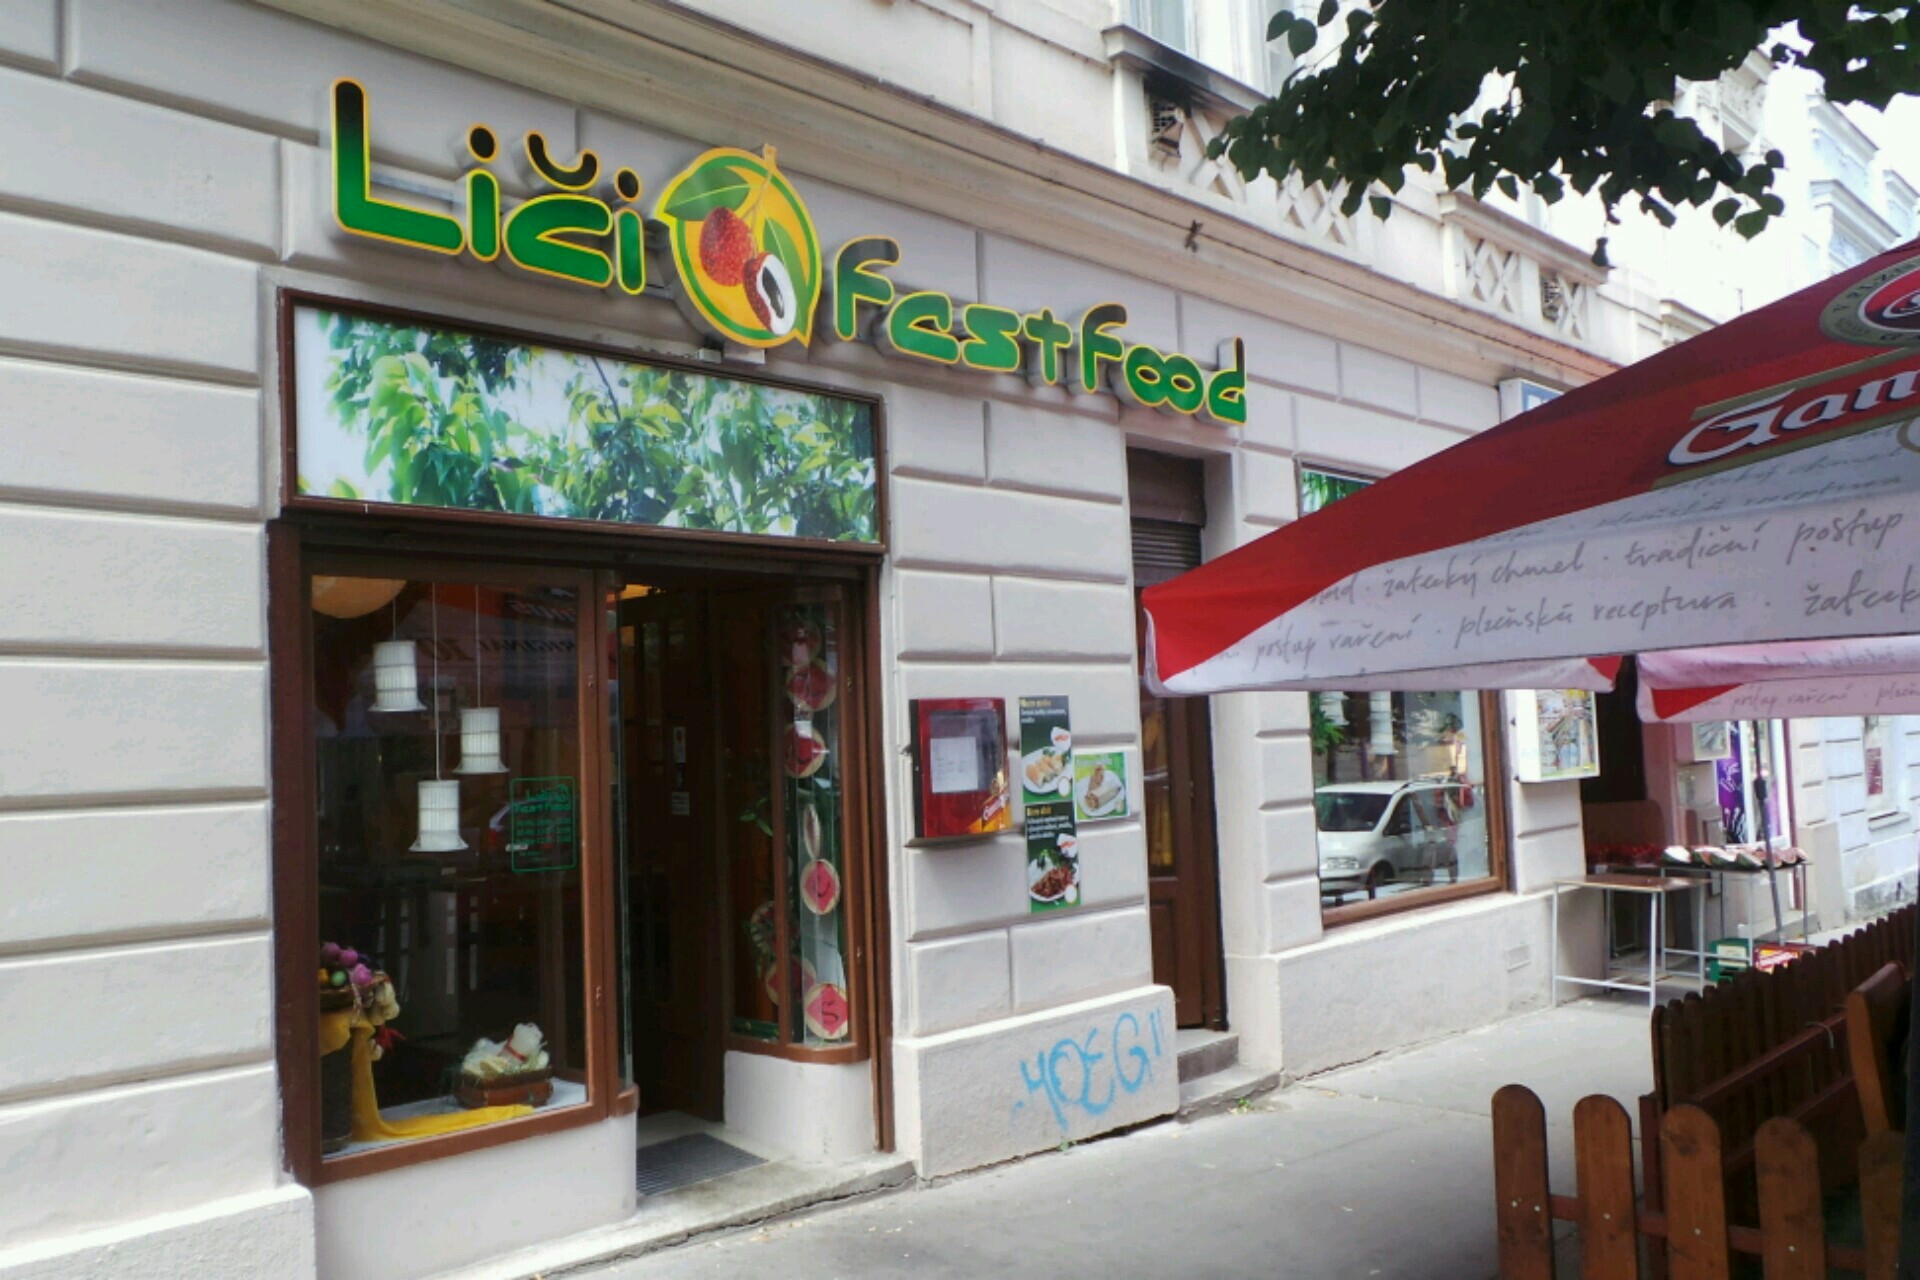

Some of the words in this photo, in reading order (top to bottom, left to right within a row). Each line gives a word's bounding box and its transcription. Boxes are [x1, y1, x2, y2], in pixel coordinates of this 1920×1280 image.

[330, 77, 645, 295] Liči
[1625, 519, 1770, 568] tradiční
[1786, 507, 1903, 565] postup
